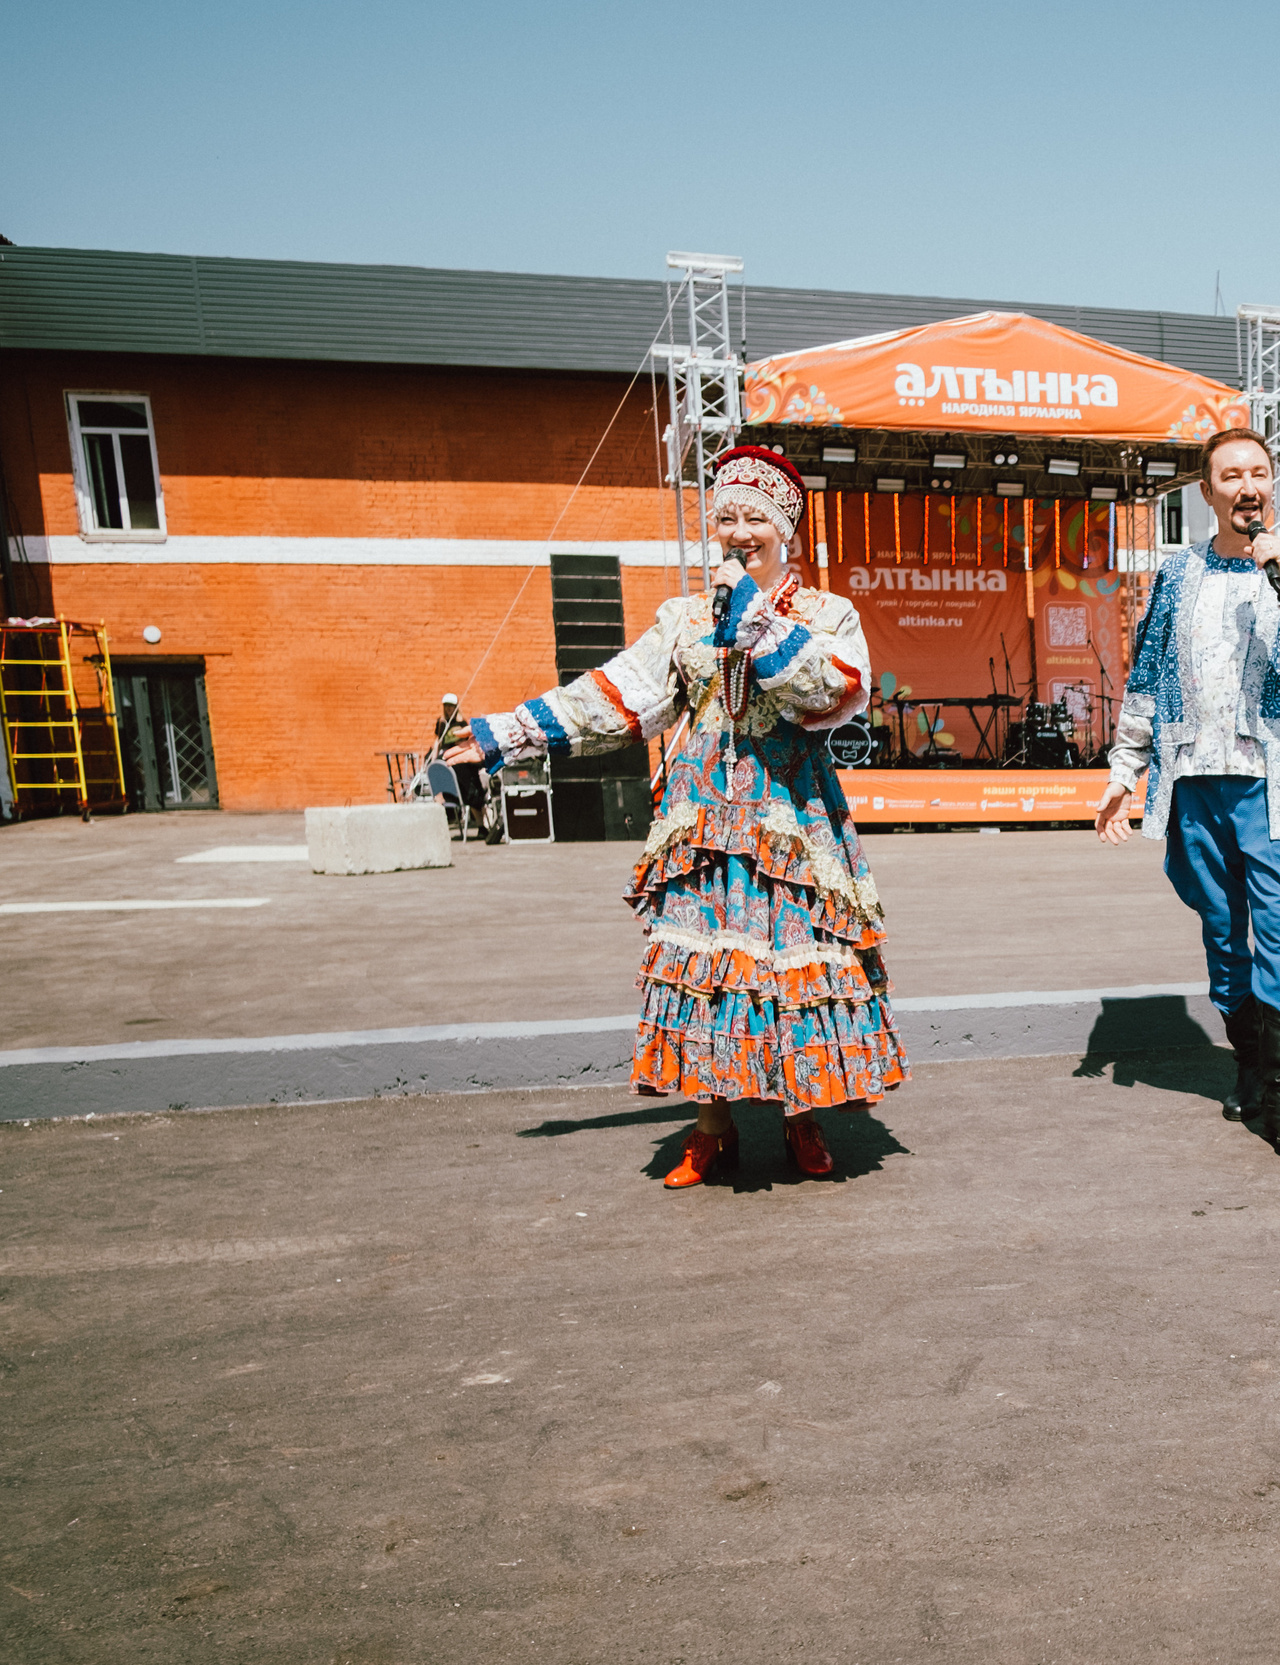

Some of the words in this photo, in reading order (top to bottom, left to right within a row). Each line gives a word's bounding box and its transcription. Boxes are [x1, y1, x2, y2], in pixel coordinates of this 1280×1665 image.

[941, 401, 1016, 417] НАРОДНАЯ
[1018, 404, 1083, 420] ЯРМАРКА
[945, 600, 977, 609] покупай
[898, 615, 963, 627] altinka.ru
[1046, 656, 1094, 665] altinka.ru
[983, 786, 1016, 795] наши
[1018, 784, 1077, 797] партнёры
